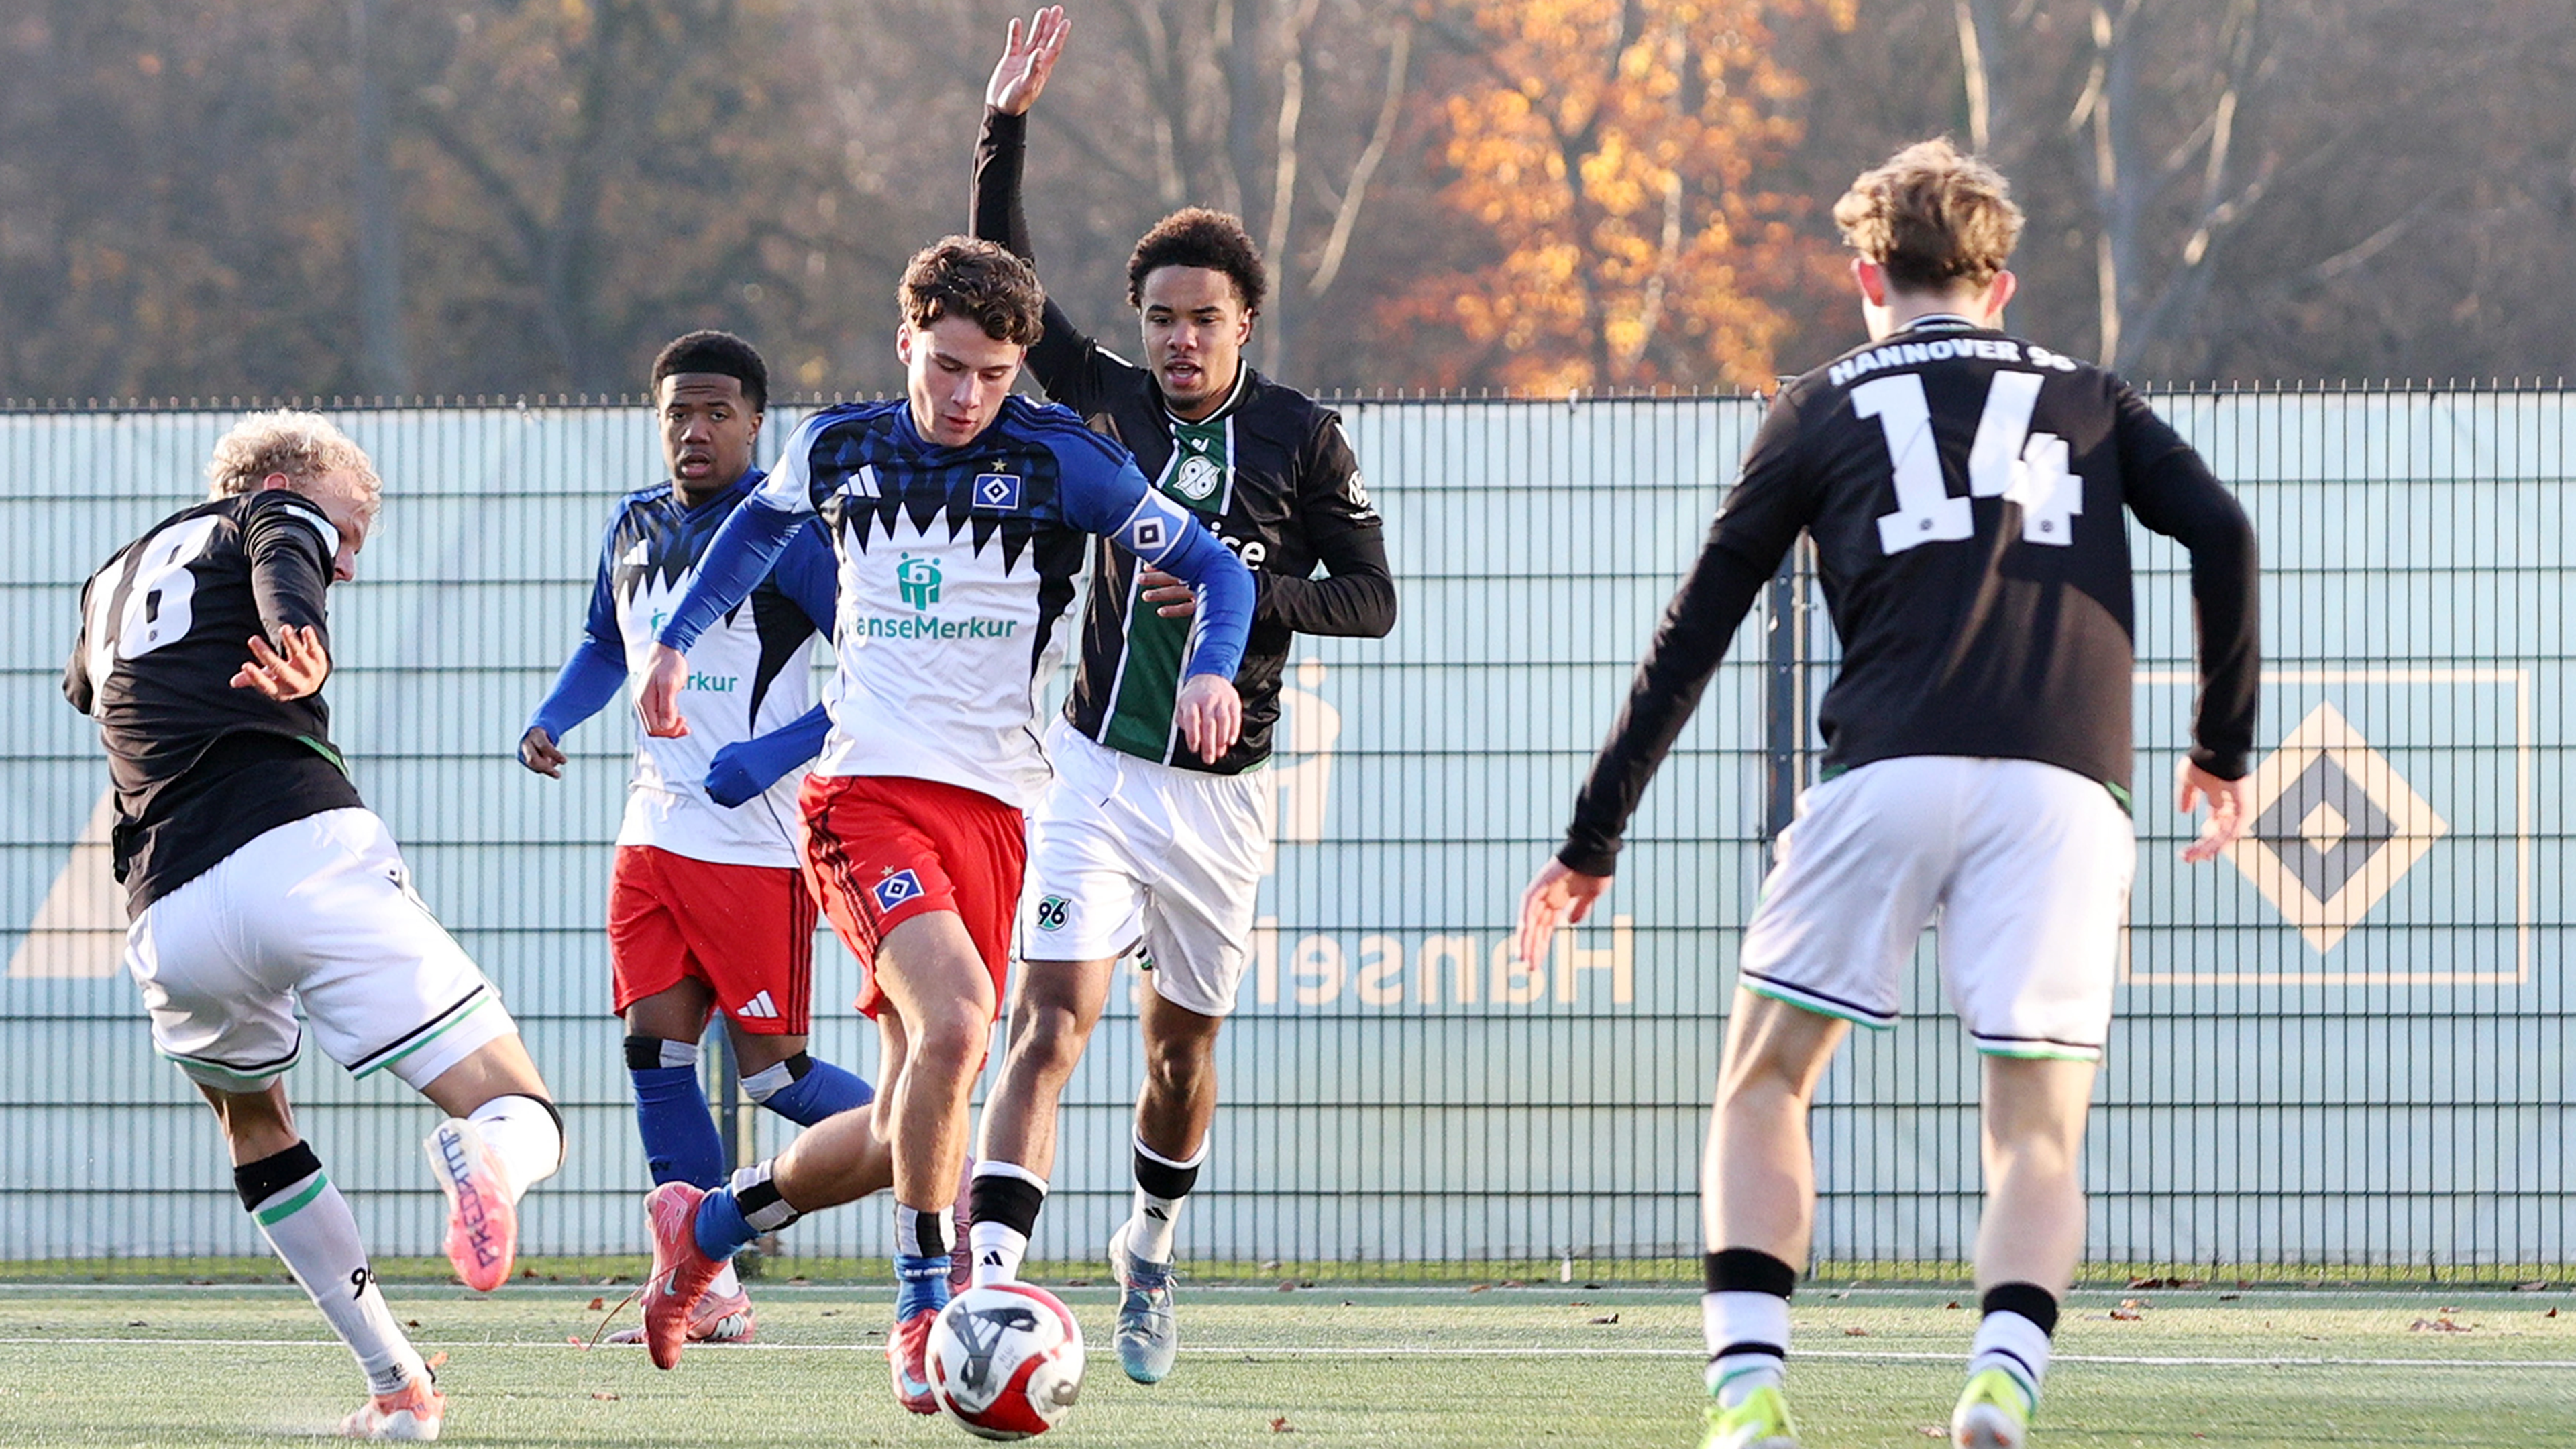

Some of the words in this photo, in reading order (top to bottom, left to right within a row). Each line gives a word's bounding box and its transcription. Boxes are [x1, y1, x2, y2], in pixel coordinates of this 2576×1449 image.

[1828, 339, 2021, 386] HANNOVER
[2027, 345, 2077, 372] 96
[1177, 459, 1218, 495] 96
[1849, 369, 2083, 556] 14
[84, 513, 219, 716] 18
[846, 615, 1018, 639] anseMerkur
[682, 671, 738, 692] rkur
[1037, 900, 1067, 926] 96
